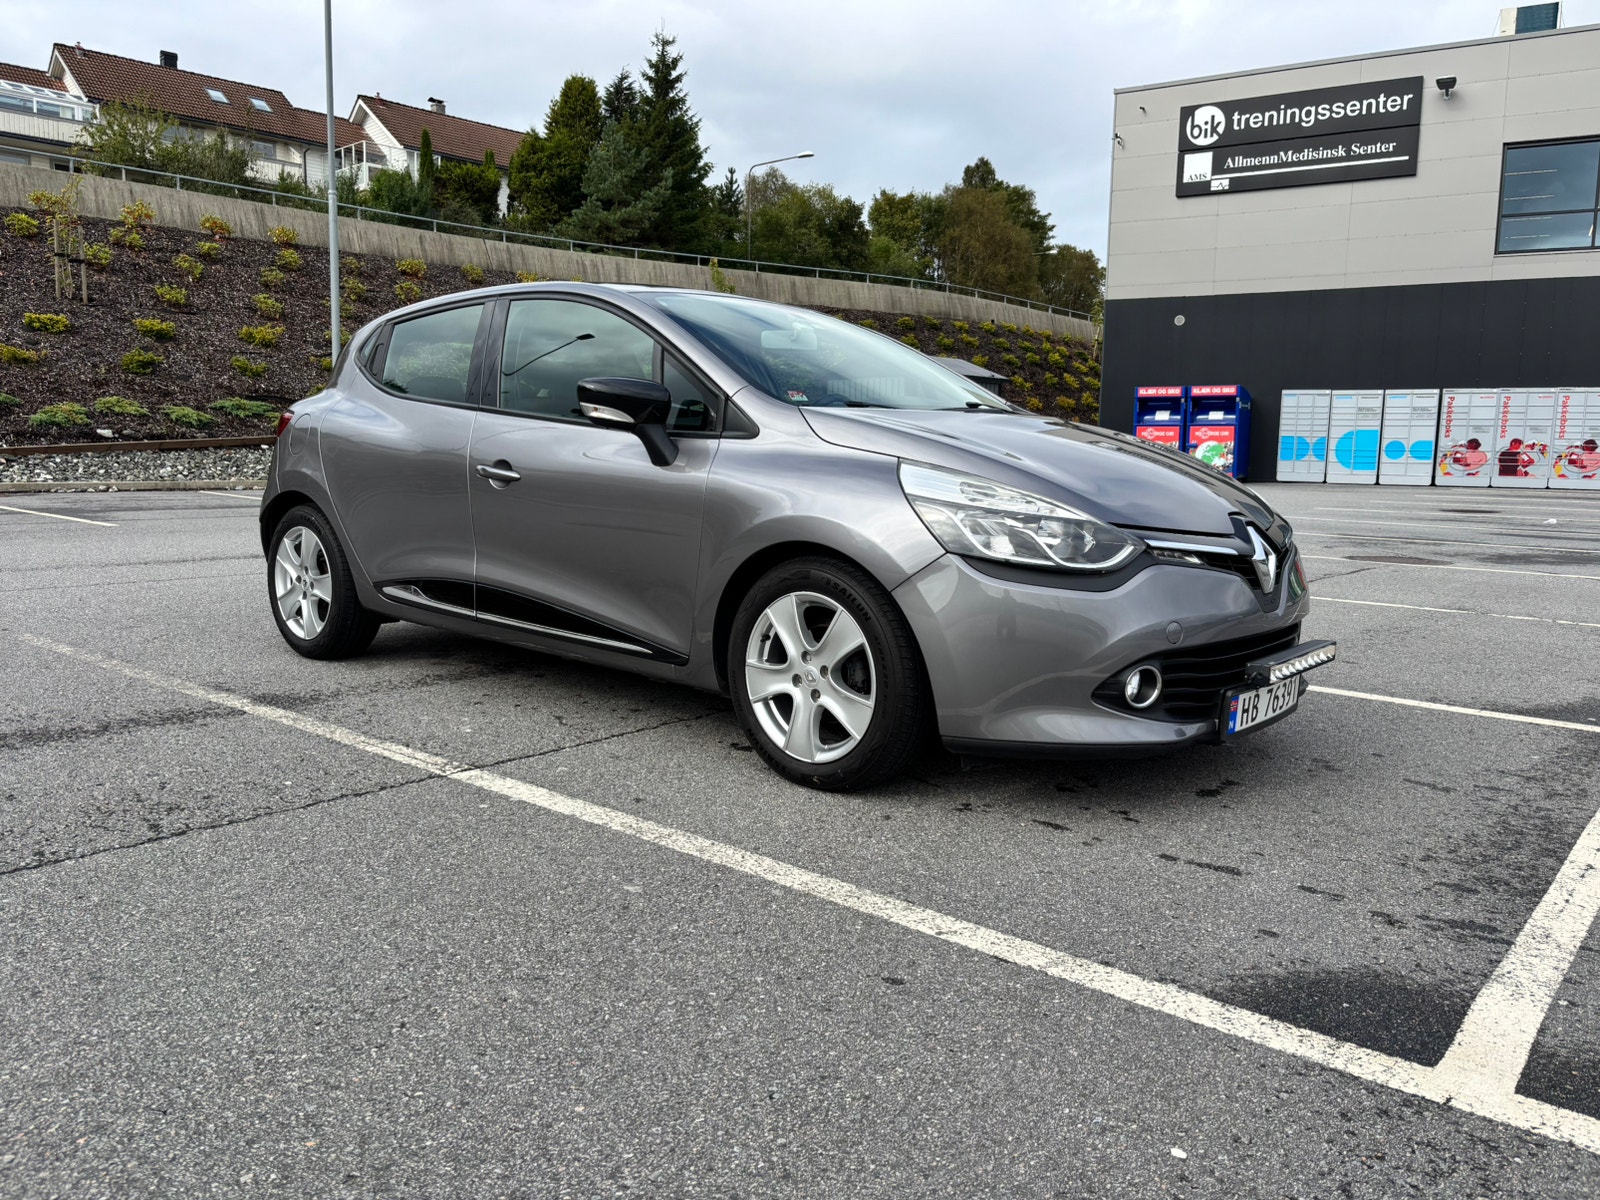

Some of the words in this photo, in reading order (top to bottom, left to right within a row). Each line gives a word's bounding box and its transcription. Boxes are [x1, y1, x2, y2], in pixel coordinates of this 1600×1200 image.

[1191, 112, 1223, 141] bik
[1232, 93, 1413, 131] treningssenter
[1224, 145, 1346, 169] AllmennMedisinsk
[1351, 141, 1396, 156] Senter
[1187, 173, 1208, 182] AMS
[831, 580, 871, 622] SAILUN
[1240, 693, 1260, 727] HB
[1264, 676, 1298, 717] 76391
[1228, 720, 1234, 729] N
